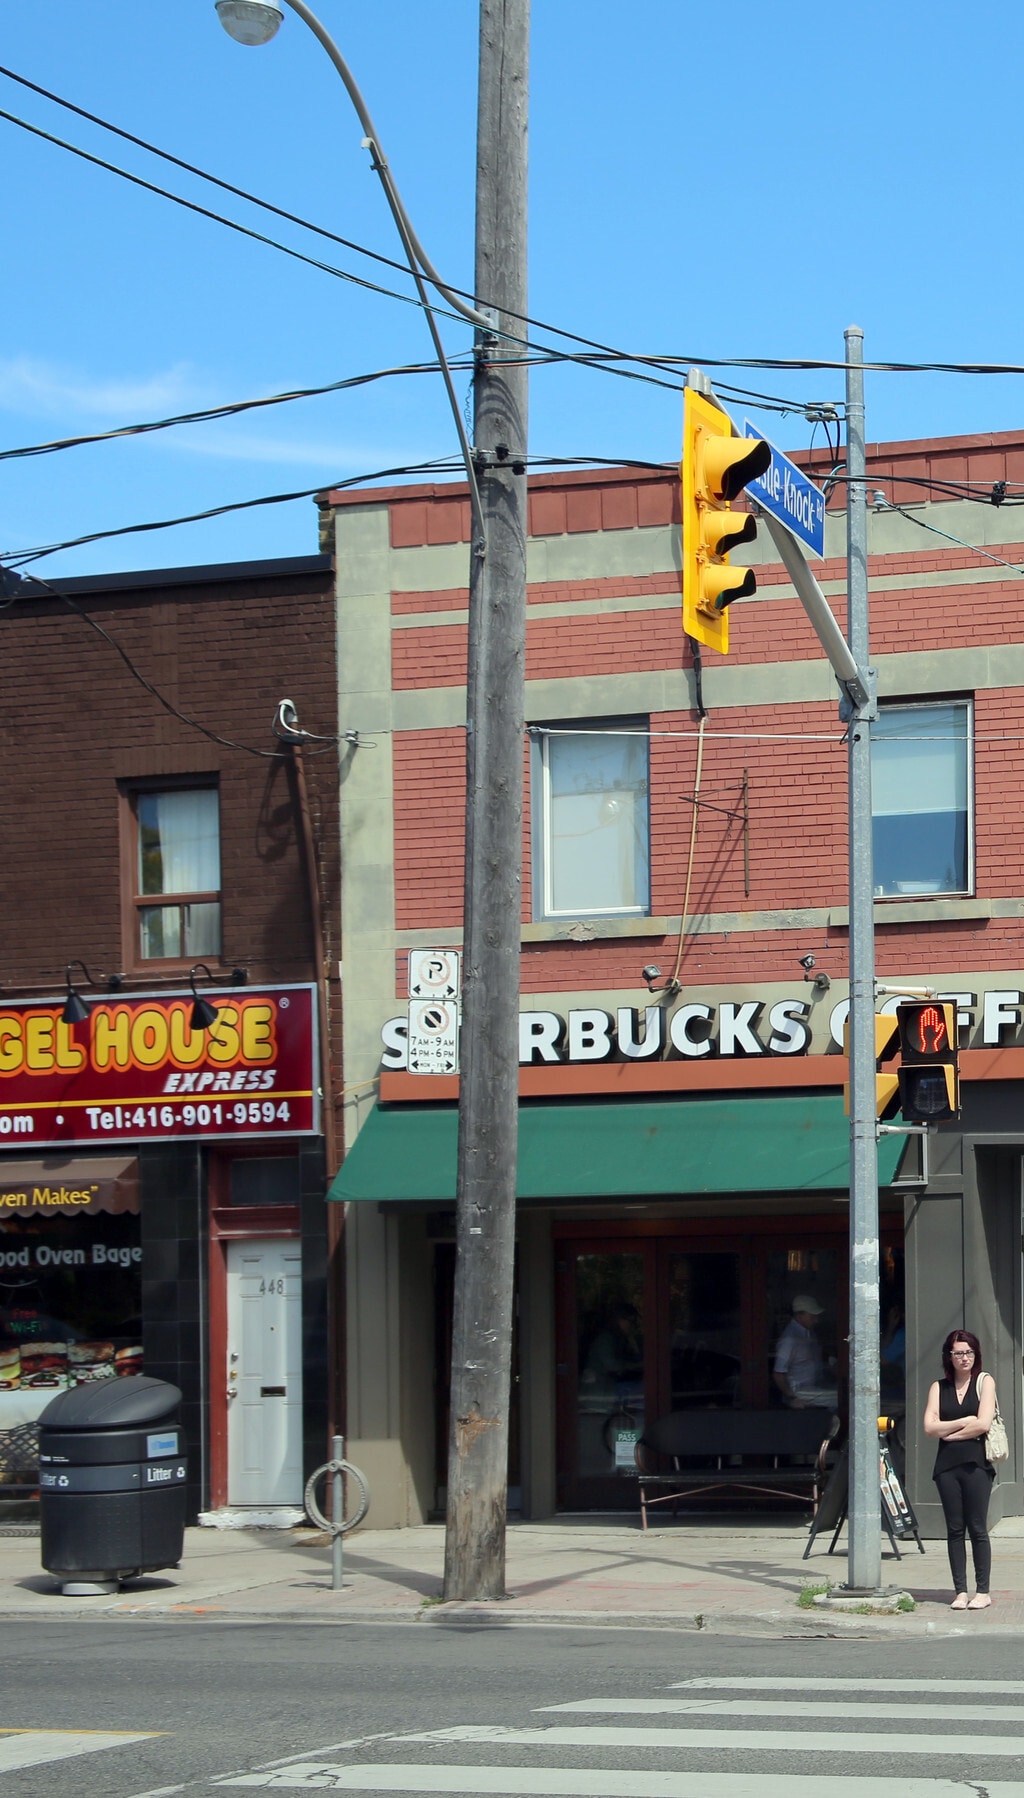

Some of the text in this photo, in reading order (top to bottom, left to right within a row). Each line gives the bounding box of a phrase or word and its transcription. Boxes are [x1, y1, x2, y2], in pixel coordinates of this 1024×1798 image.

[783, 467, 815, 533] Knock
[93, 1003, 274, 1067] HOUSE
[381, 998, 809, 1068] SRBUCKS
[163, 1069, 277, 1093] EXPRESS
[86, 1101, 290, 1130] Tel:416-901-9594
[36, 1246, 85, 1265] Oven
[259, 1279, 284, 1295] 448
[618, 1433, 636, 1441] PASS
[147, 1467, 173, 1482] Litter
